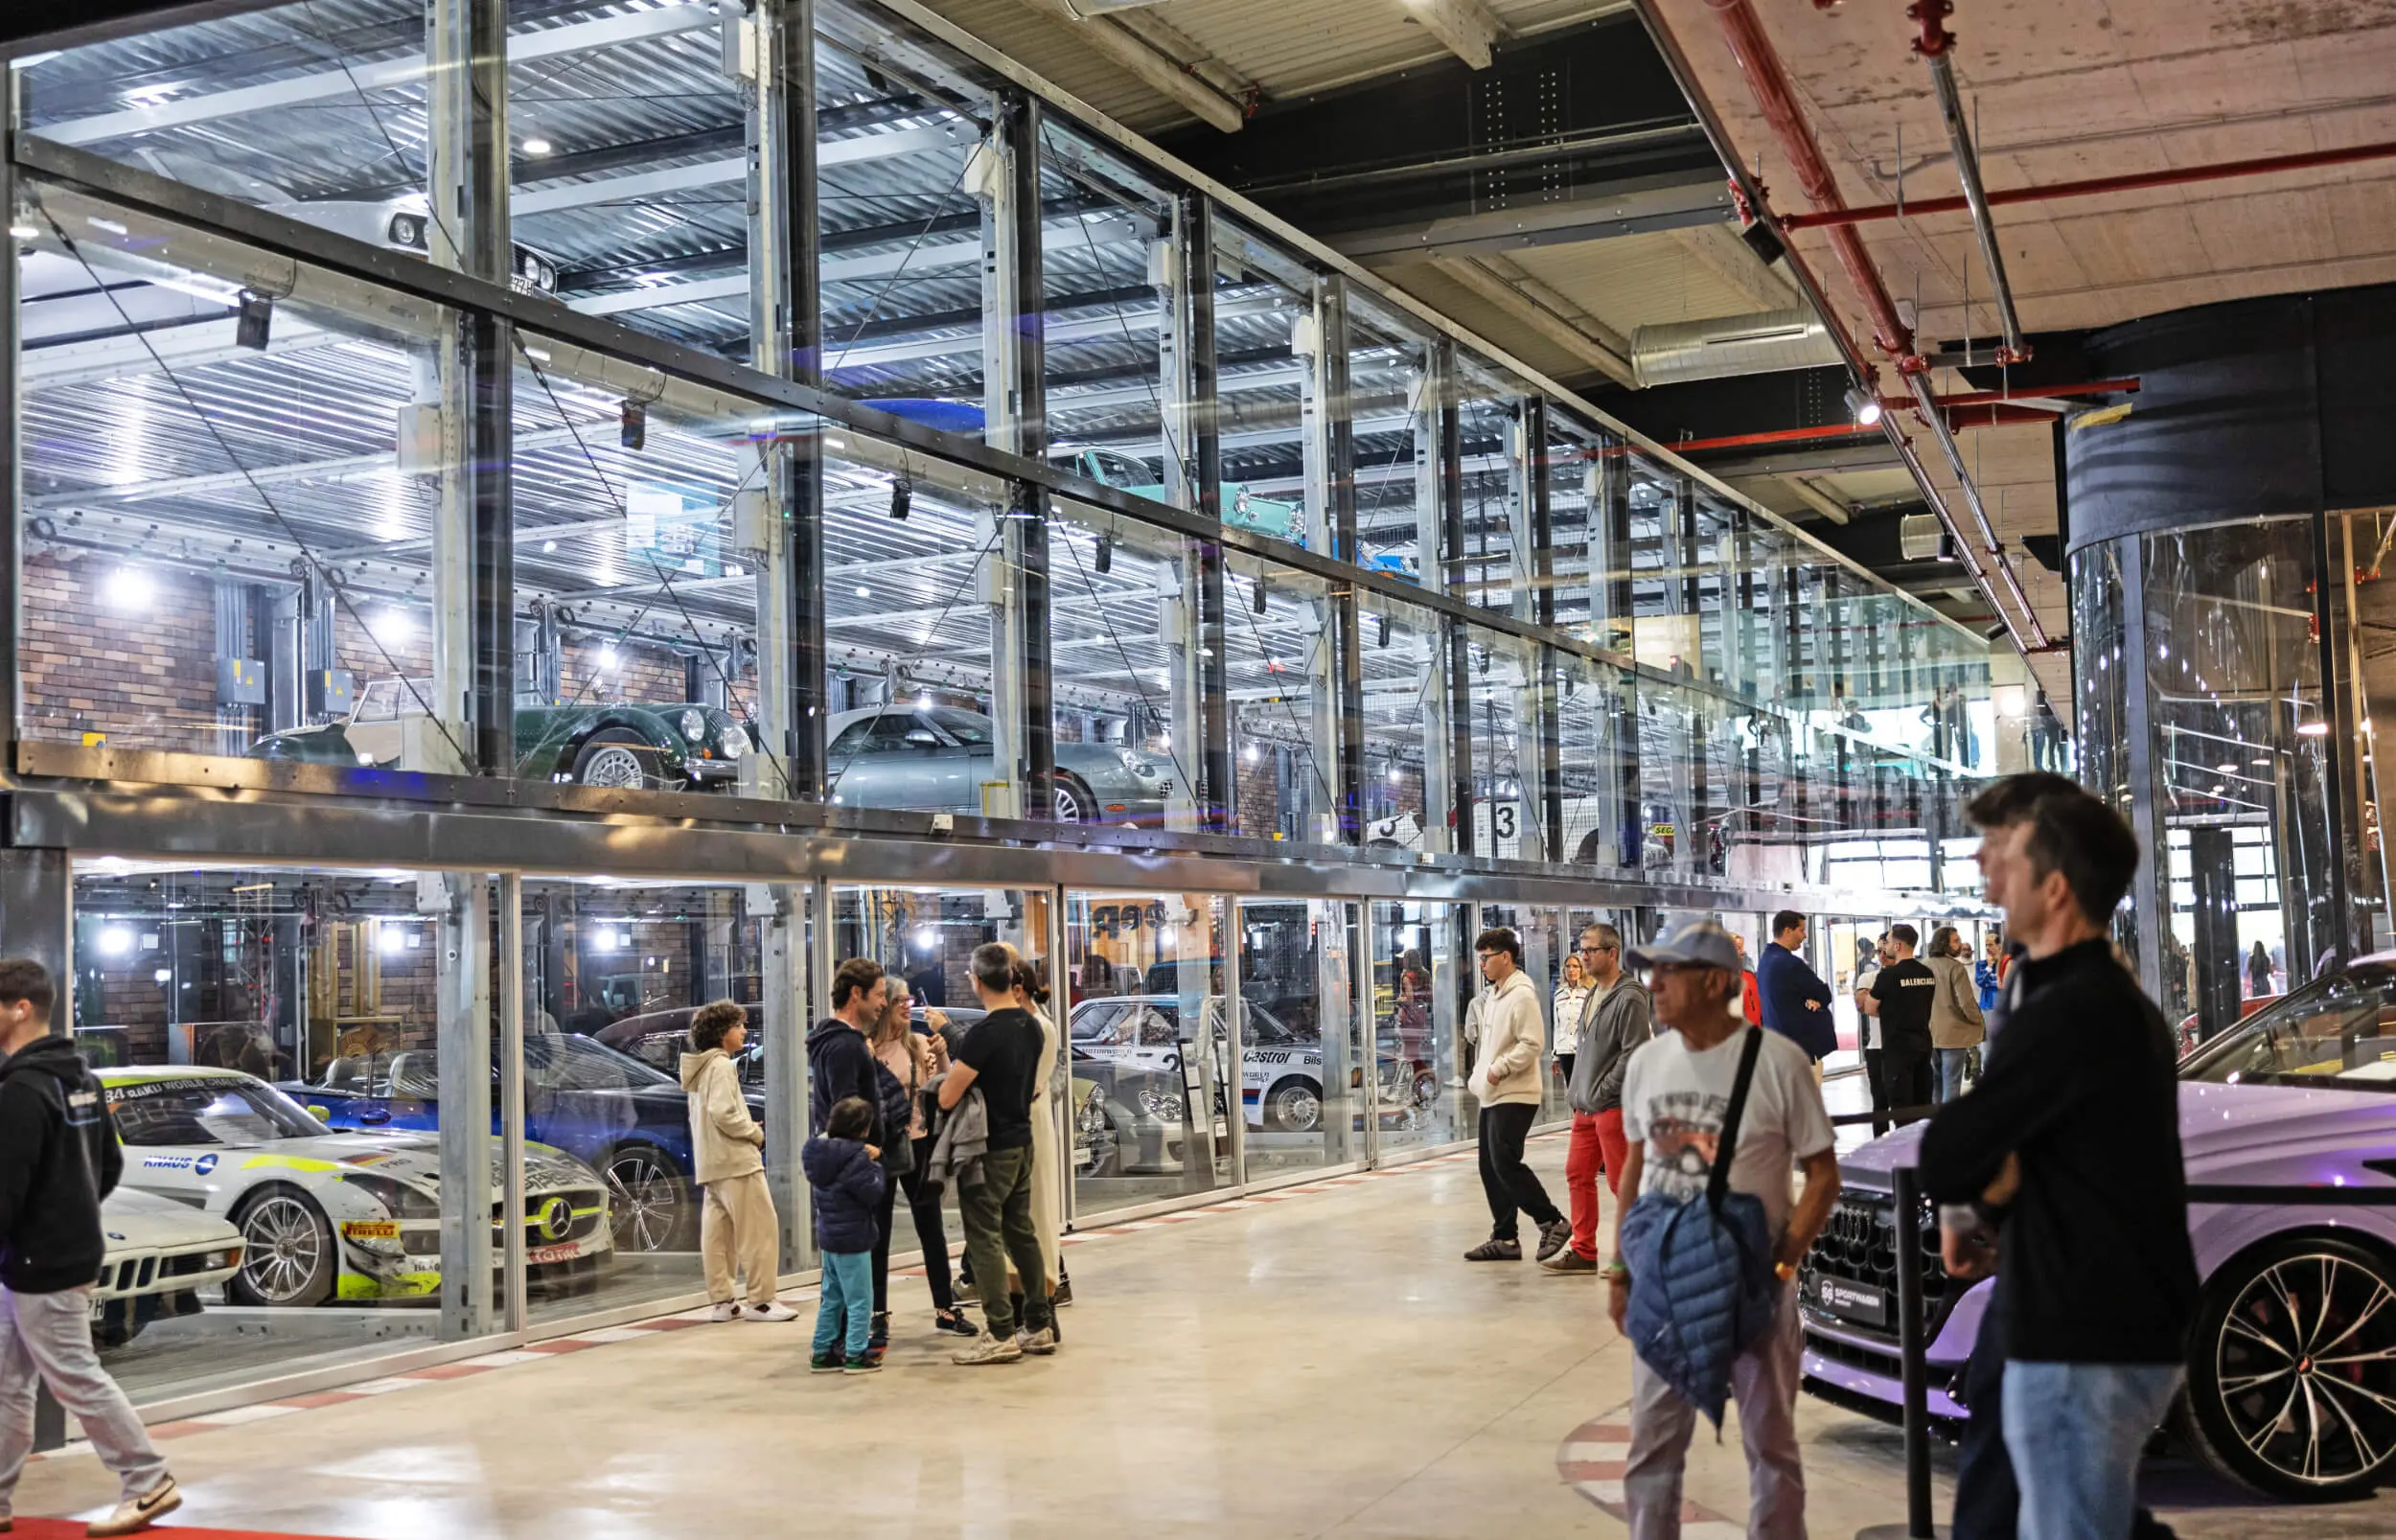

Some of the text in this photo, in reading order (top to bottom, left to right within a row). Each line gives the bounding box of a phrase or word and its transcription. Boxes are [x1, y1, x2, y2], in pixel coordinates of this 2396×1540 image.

[1495, 807, 1515, 839] 3
[1243, 1051, 1292, 1064] Castrol
[1303, 1055, 1323, 1066] Bils
[164, 1077, 205, 1091] WORLD
[143, 1155, 193, 1169] KNAUS
